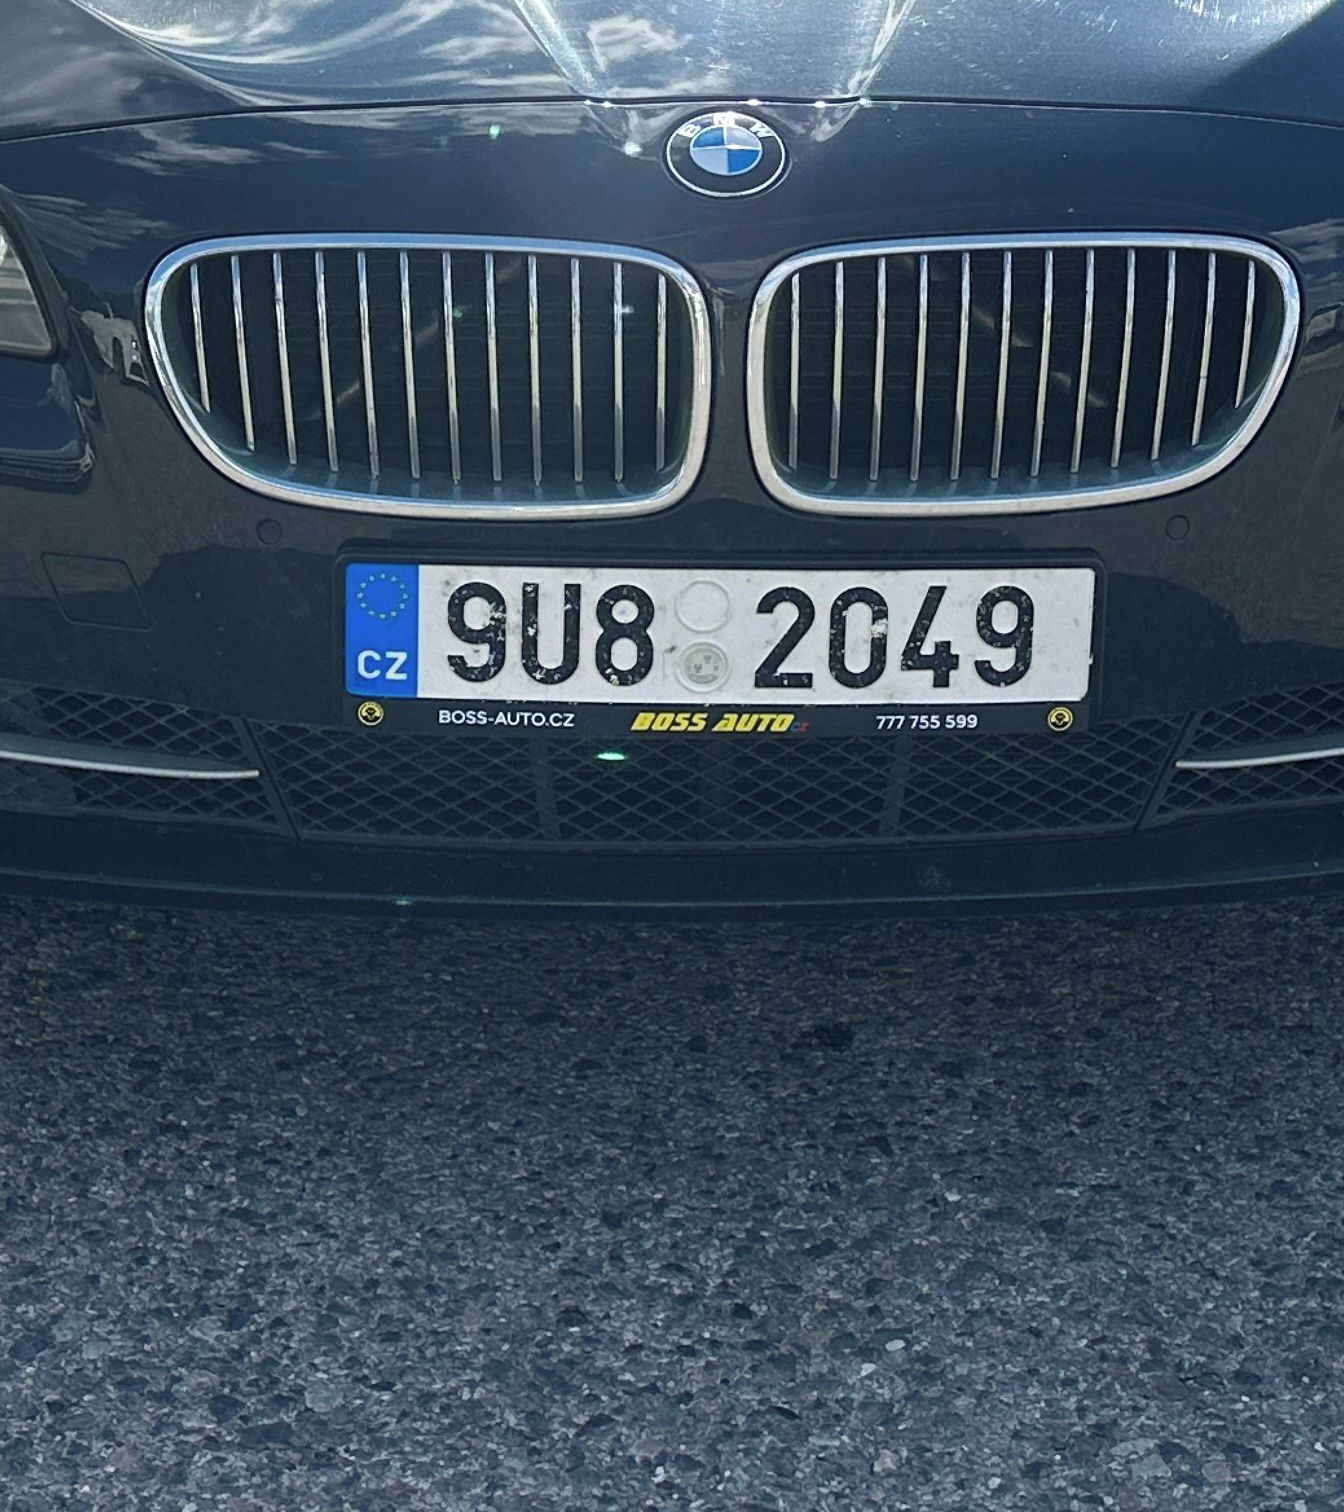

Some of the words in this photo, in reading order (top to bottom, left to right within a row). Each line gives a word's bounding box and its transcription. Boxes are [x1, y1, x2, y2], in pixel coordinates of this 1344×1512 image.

[446, 582, 656, 687] 9U8
[753, 584, 1037, 689] 2049
[356, 651, 409, 681] CZ
[438, 709, 576, 728] BOSS-AUTO.CZ
[629, 711, 709, 732] BOSS
[711, 712, 796, 733] AUTO
[875, 714, 905, 730] 777
[909, 714, 941, 730] 755
[945, 714, 979, 730] 599
